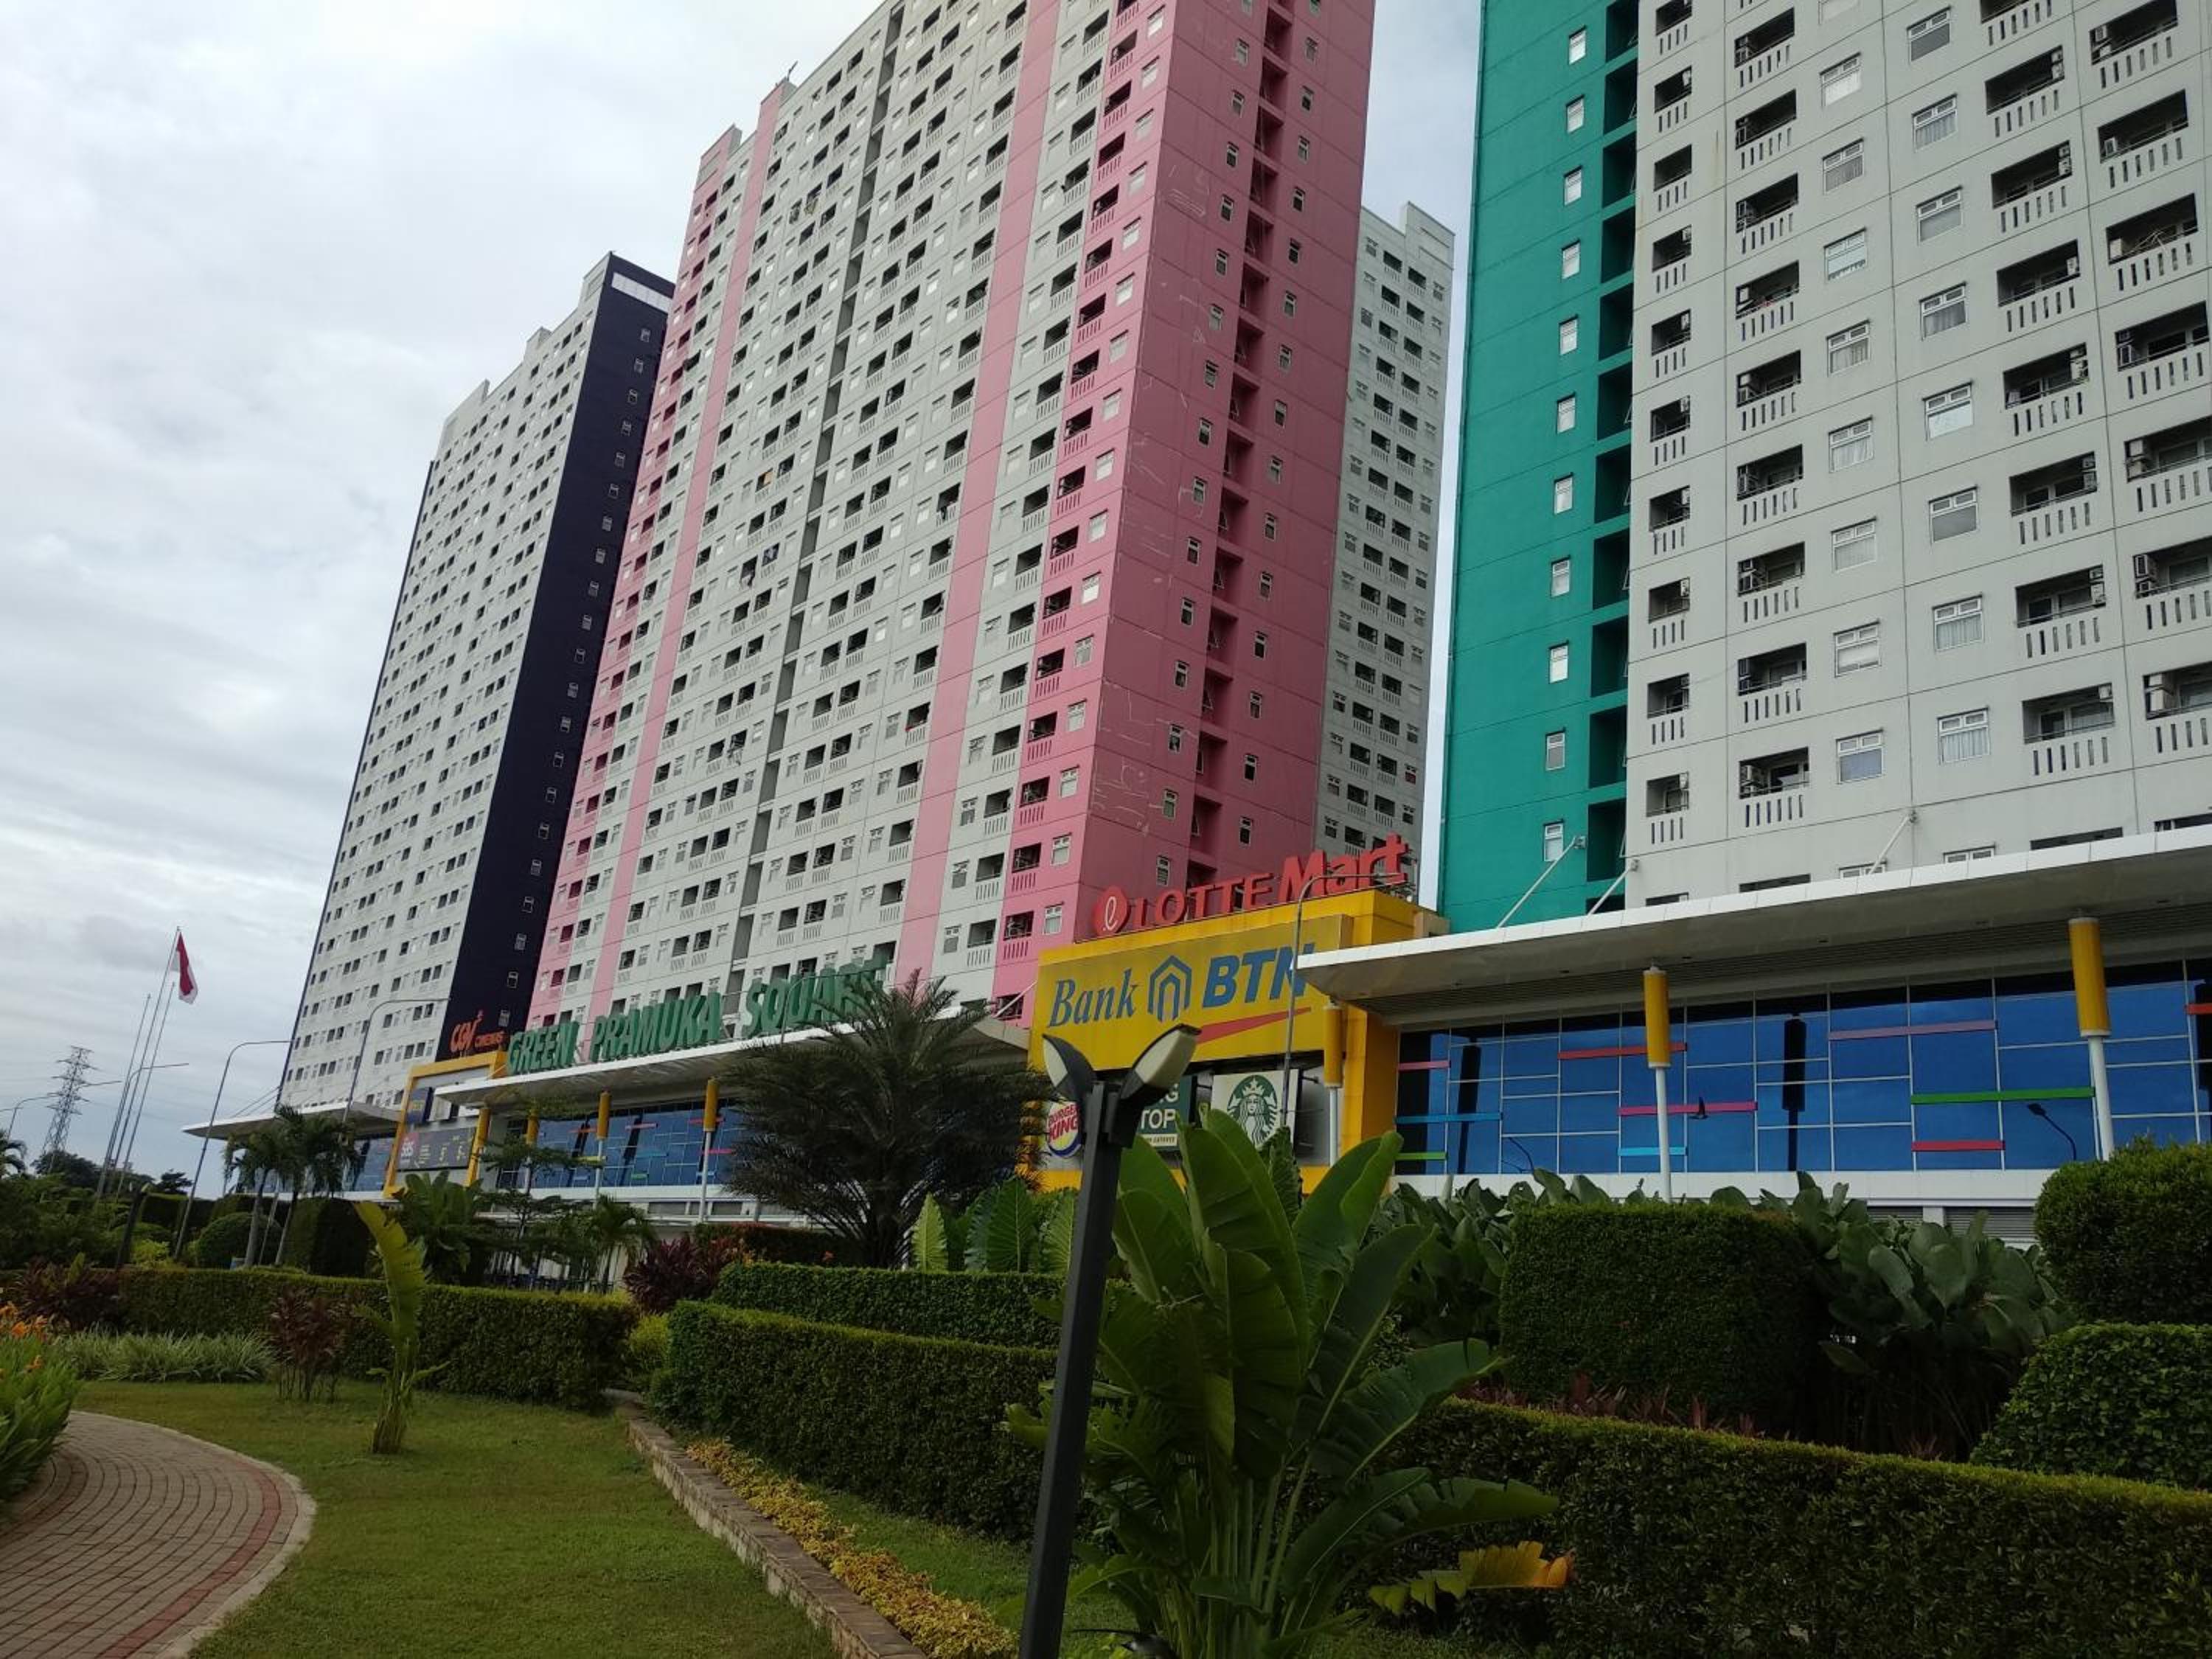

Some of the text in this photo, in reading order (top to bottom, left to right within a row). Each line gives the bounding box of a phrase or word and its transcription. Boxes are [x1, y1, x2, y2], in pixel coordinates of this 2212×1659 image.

[1129, 832, 1409, 930] LOTTE Mart
[1046, 943, 1315, 1028] Bank BTN
[508, 1022, 579, 1075] GREEN
[591, 992, 720, 1063] PRAMUKA
[1049, 1116, 1078, 1141] KING
